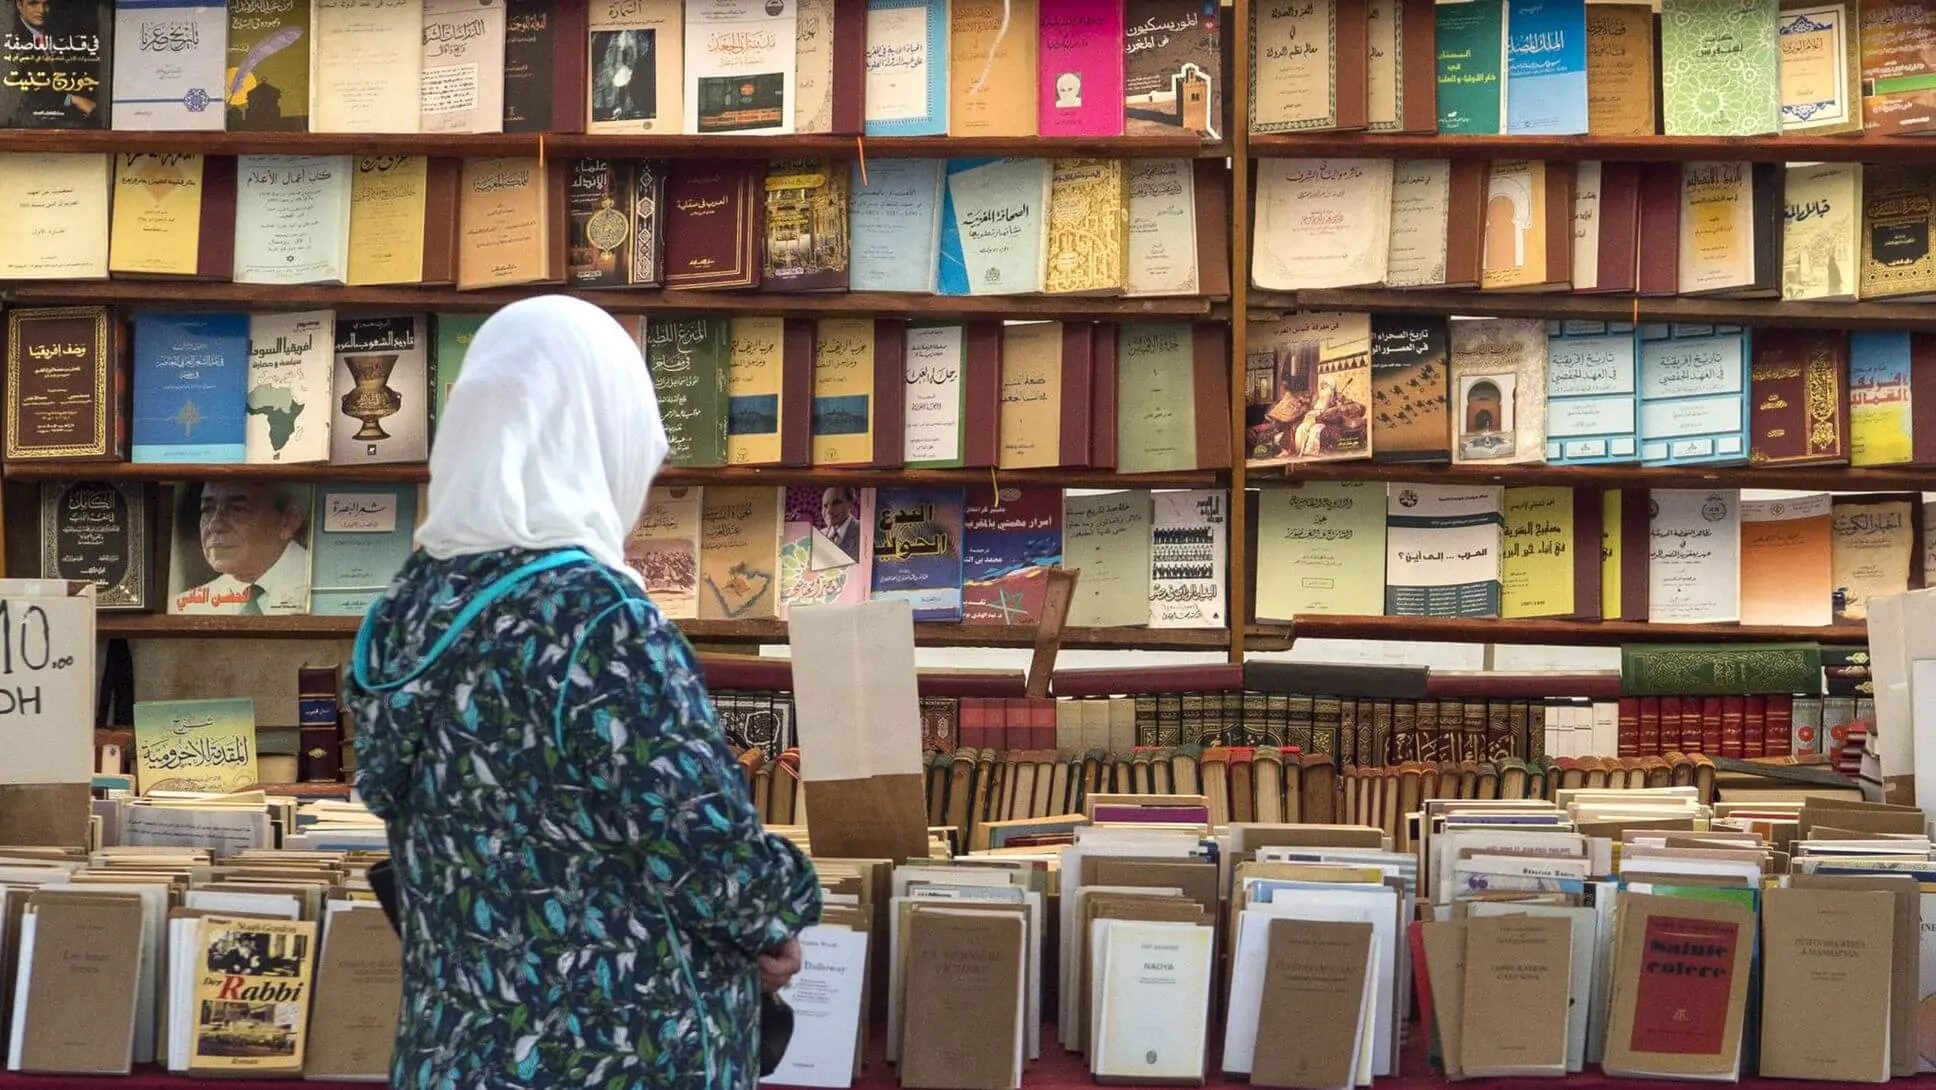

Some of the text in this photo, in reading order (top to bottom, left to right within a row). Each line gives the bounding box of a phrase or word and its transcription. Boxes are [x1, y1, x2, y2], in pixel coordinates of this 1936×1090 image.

[4, 34, 99, 56] في قلب العاصفة
[3, 70, 100, 92] جورج تنيت
[572, 173, 608, 188] الأندل
[707, 194, 729, 208] العرب
[961, 203, 1030, 227] الصحافة المغربية
[1377, 329, 1429, 342] تاريخ الصحراء
[62, 343, 87, 358] وصف
[1383, 343, 1417, 355] العصور
[1416, 343, 1430, 354] في
[1586, 352, 1616, 368] تاريخ
[1693, 352, 1722, 368] تاريخ
[964, 516, 1053, 532] أسرار مهمتي بالمغرب
[1397, 551, 1405, 562] ؟
[1404, 550, 1422, 564] أين
[1422, 551, 1445, 563] إلى
[1457, 547, 1489, 561] العرب
[173, 717, 213, 735] شرح
[210, 735, 249, 767] المقدمة
[203, 974, 306, 1003] Der Rabbi
